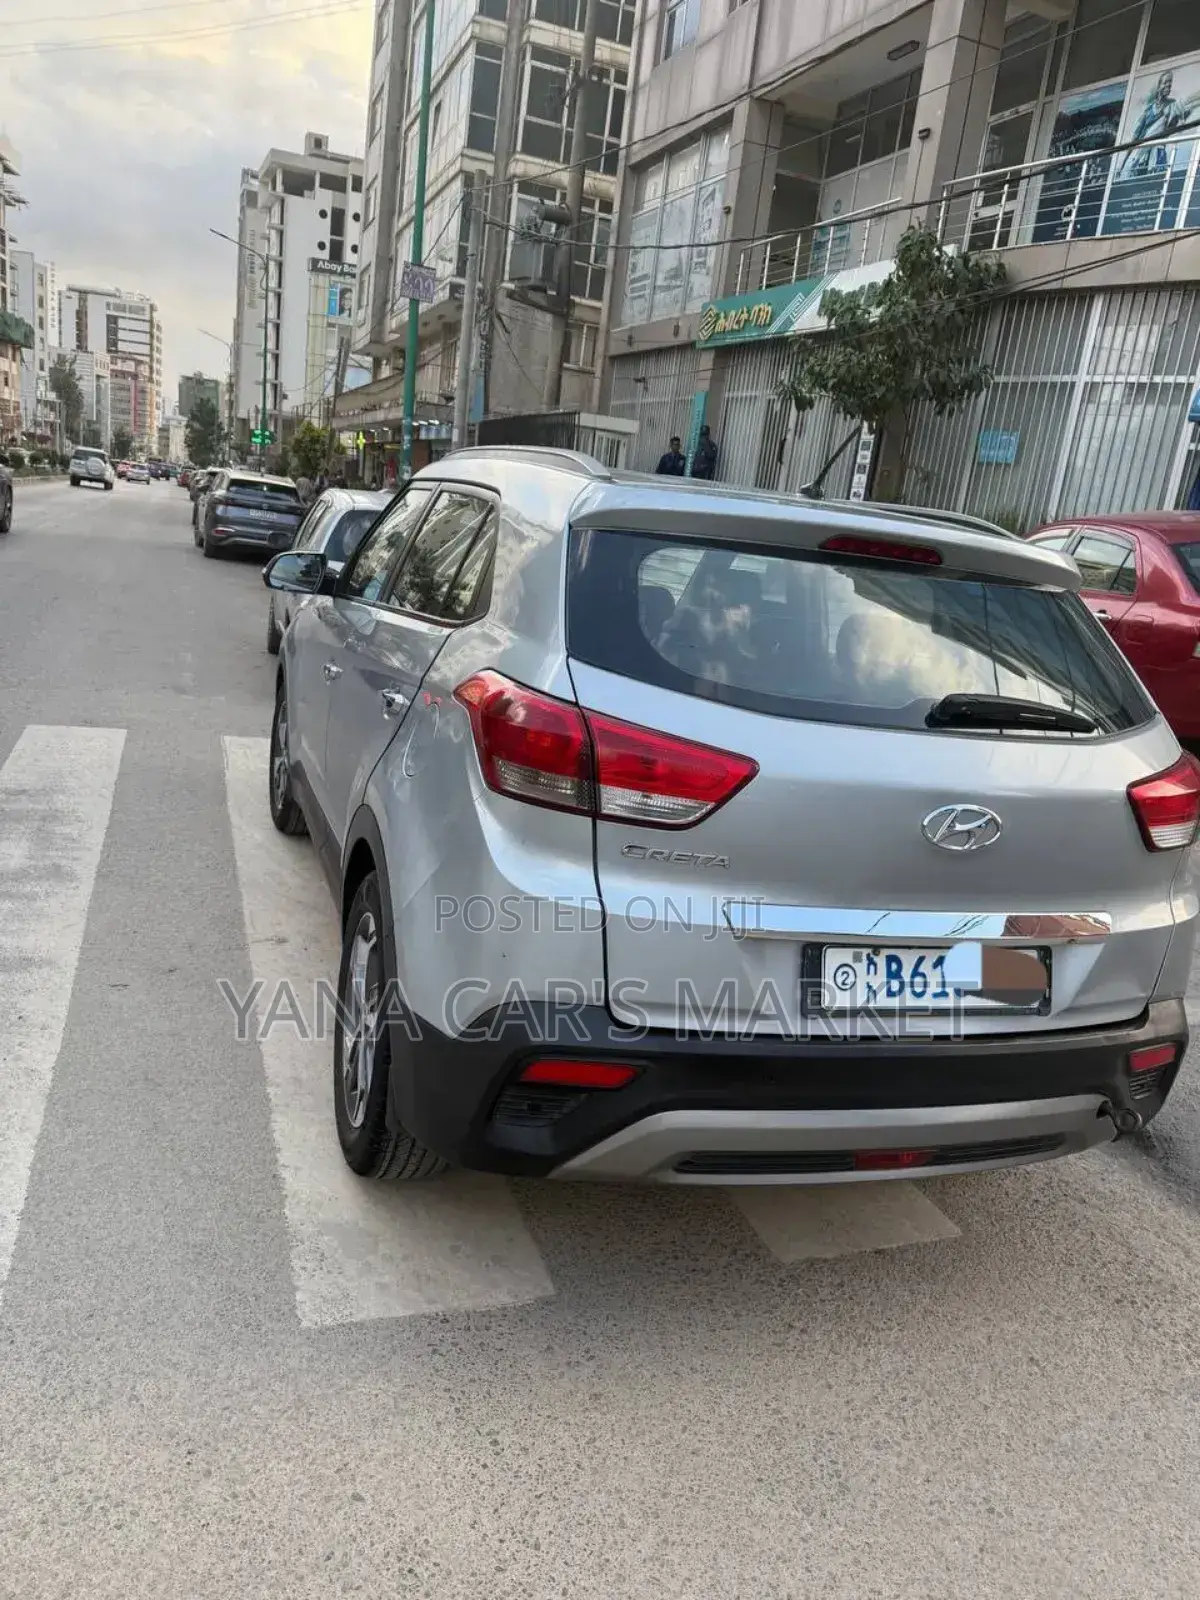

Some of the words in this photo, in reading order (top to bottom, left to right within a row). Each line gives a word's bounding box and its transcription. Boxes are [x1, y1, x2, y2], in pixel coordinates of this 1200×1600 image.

[317, 260, 342, 273] Abay
[621, 843, 731, 869] CRETA
[885, 954, 963, 999] B61
